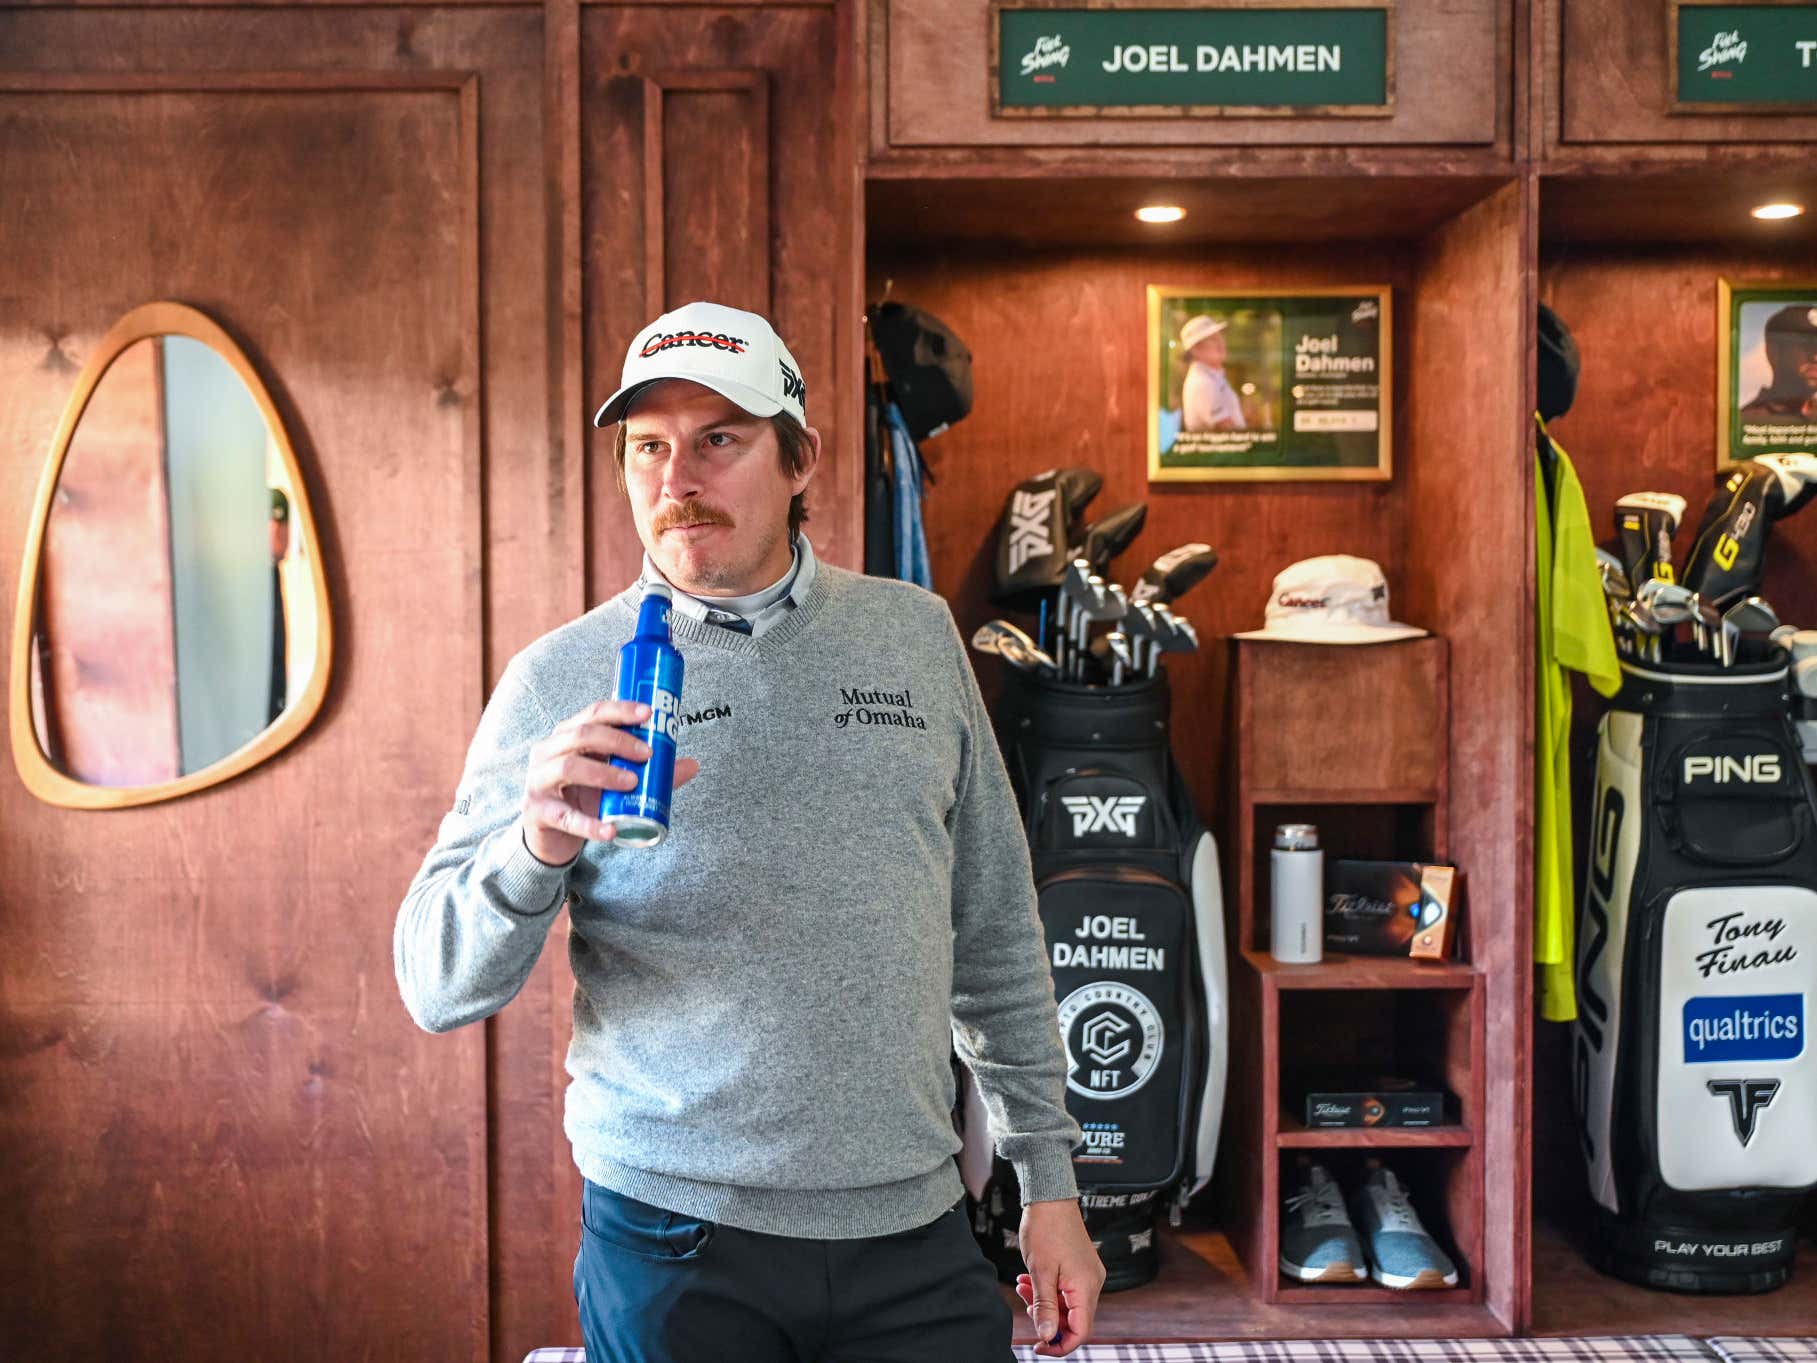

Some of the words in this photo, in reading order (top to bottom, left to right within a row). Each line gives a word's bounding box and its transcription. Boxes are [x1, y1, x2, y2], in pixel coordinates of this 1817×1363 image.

[1102, 45, 1189, 73] JOEL
[1197, 45, 1342, 73] DAHMEN
[640, 330, 746, 359] Cancer
[1296, 334, 1339, 354] Joel
[1295, 354, 1376, 373] Dahmen
[840, 688, 913, 708] Mutual
[834, 708, 853, 729] of
[856, 708, 927, 731] Omaha
[1684, 754, 1781, 784] PING
[1075, 915, 1146, 940] JOEL
[1706, 911, 1787, 945] Tony
[1052, 942, 1165, 972] DAHMEN
[1695, 945, 1797, 979] Finau
[1689, 1010, 1798, 1050] qualtrics
[1090, 1069, 1121, 1089] NFT
[1654, 1240, 1699, 1256] PLAY
[1702, 1244, 1748, 1257] YOUR
[1751, 1239, 1784, 1256] BEST
